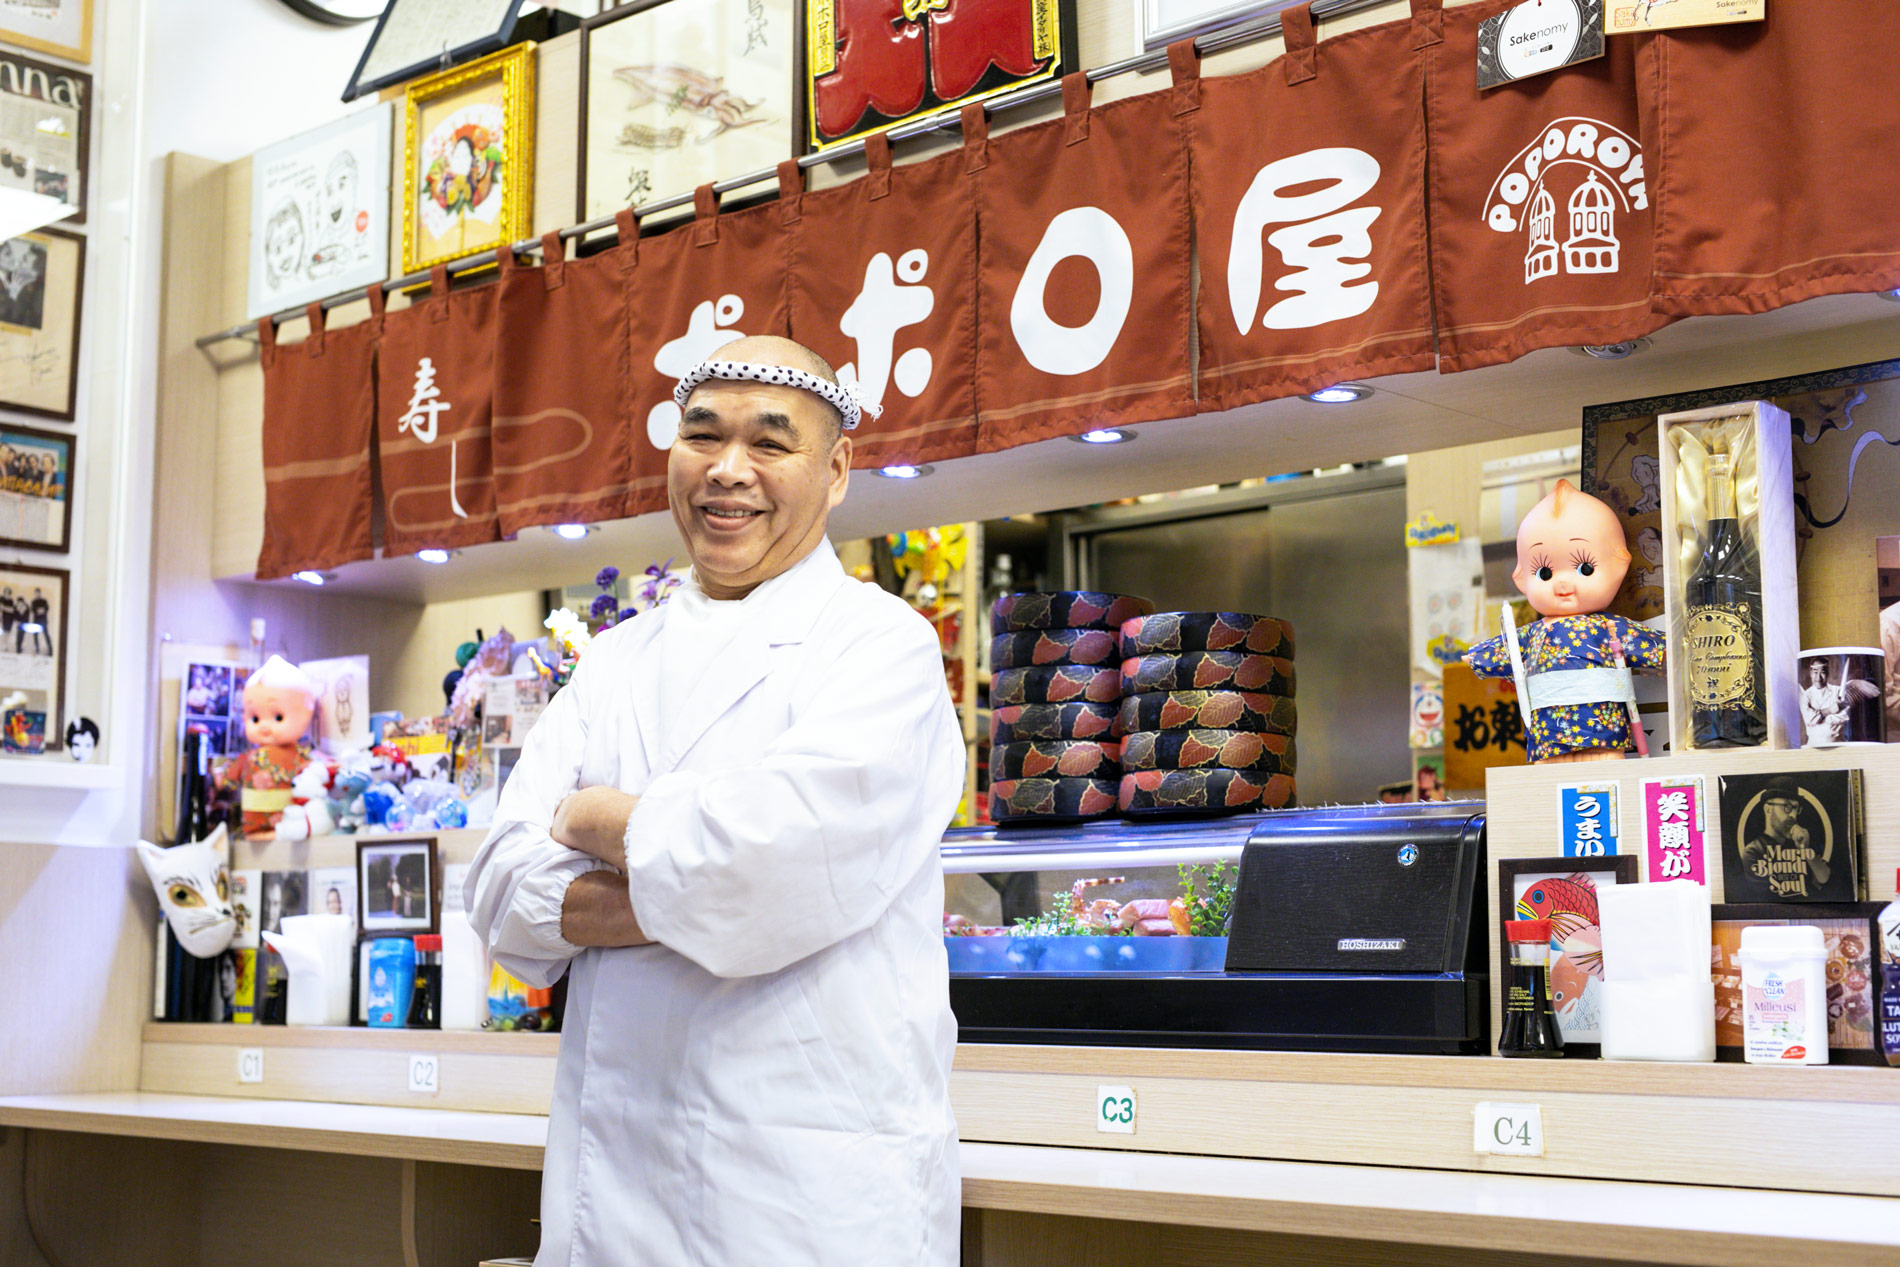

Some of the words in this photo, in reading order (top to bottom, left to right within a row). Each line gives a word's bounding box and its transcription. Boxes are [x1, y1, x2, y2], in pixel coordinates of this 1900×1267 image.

[1509, 22, 1569, 47] Sakenomy
[1693, 635, 1736, 649] SHIRO
[1574, 796, 1606, 857] うまい
[1657, 792, 1691, 877] 笑顔が
[1763, 844, 1816, 861] Mario
[1751, 858, 1808, 878] Biondi
[1768, 874, 1809, 898] Soul
[1341, 940, 1400, 950] HOSHIZAKI
[242, 1053, 261, 1077] C1
[413, 1061, 435, 1086] C2
[1102, 1096, 1133, 1123] C3
[1494, 1117, 1532, 1146] C4
